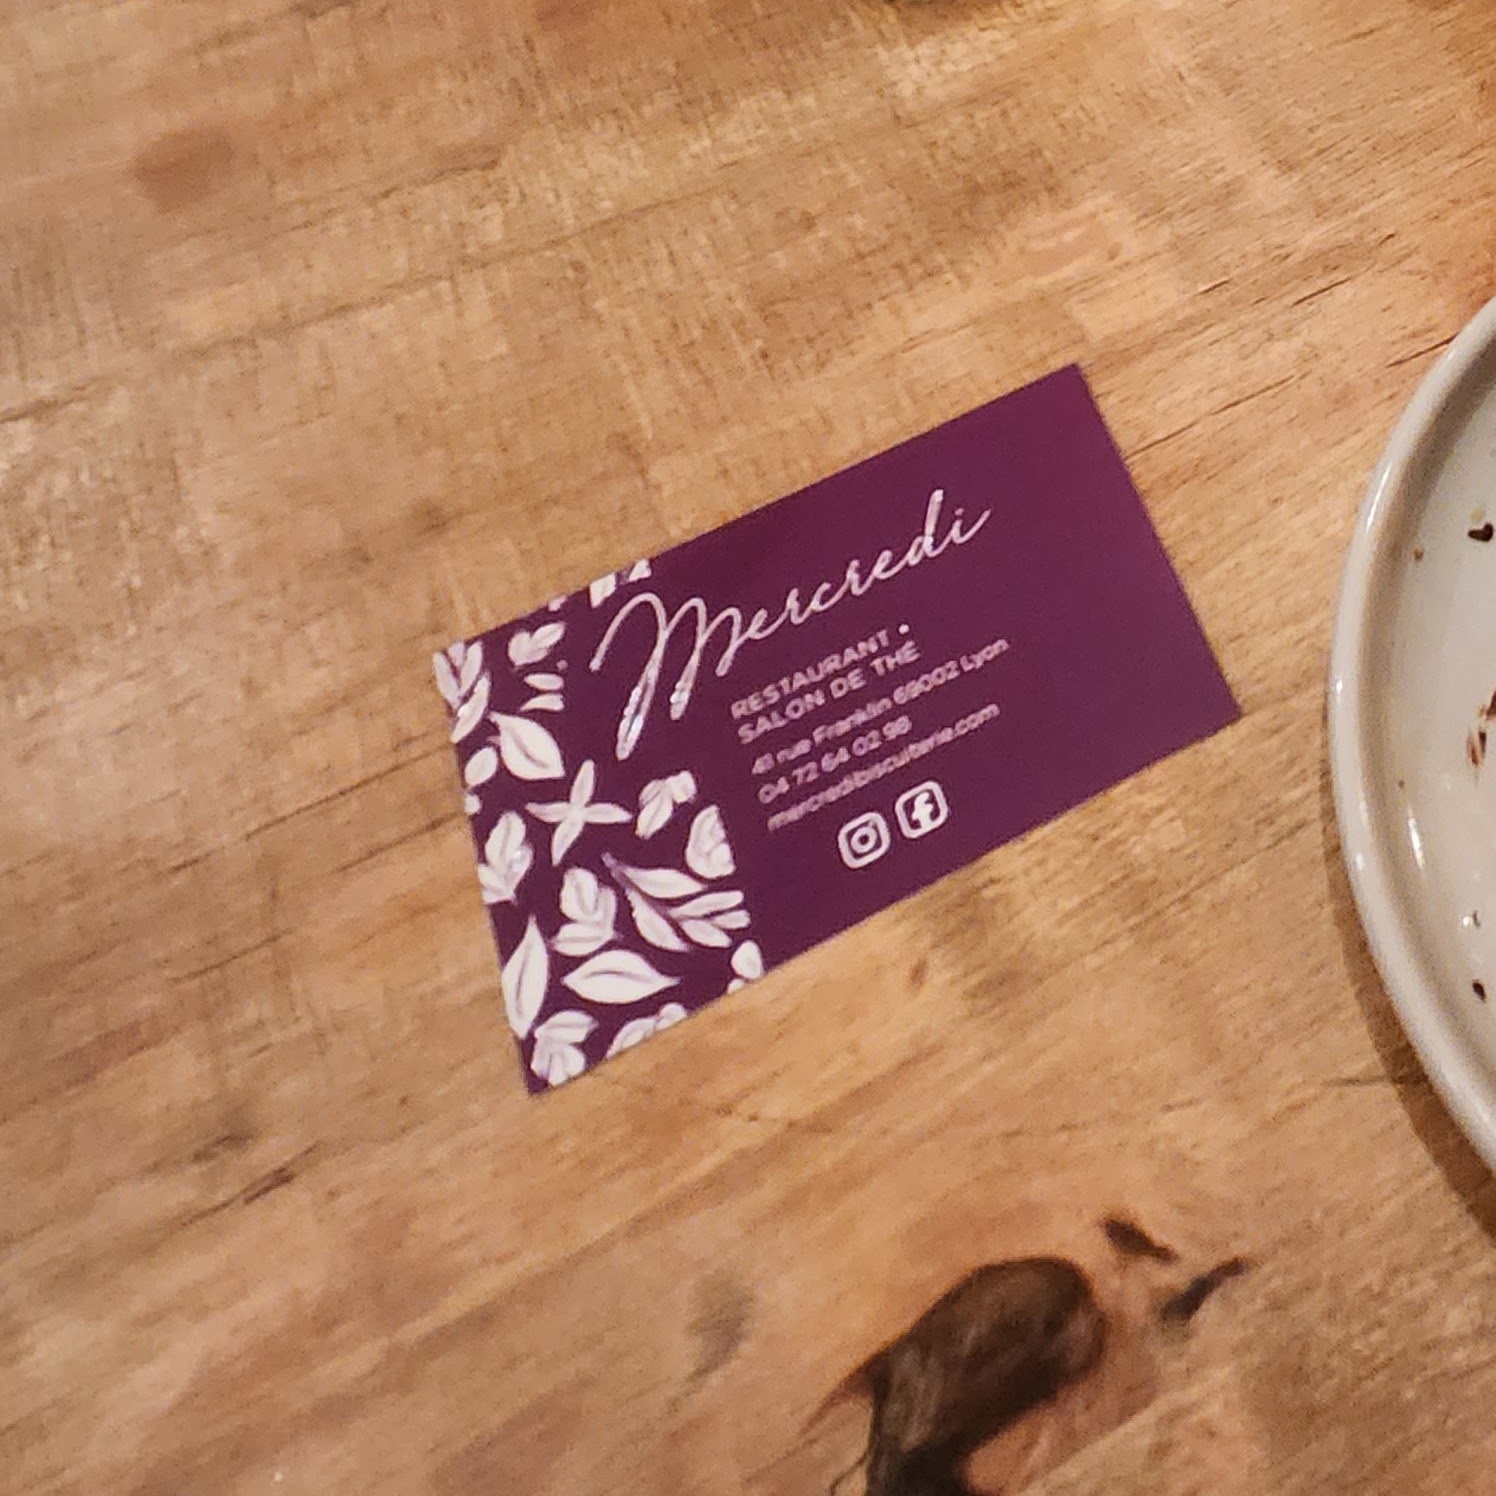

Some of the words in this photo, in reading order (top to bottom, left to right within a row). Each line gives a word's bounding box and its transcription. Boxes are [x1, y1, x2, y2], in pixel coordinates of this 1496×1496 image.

[589, 488, 992, 761] Mercredi
[731, 629, 890, 720] RESTAURANT
[737, 689, 826, 744] SALON
[830, 668, 867, 699] DE
[871, 640, 921, 676] THÉ
[776, 739, 812, 764] rue
[813, 697, 892, 745] Franklin
[960, 639, 1010, 672] Lyon
[759, 776, 790, 804] 04
[792, 761, 819, 785] 72
[821, 747, 851, 772] 64
[852, 730, 882, 757] 02
